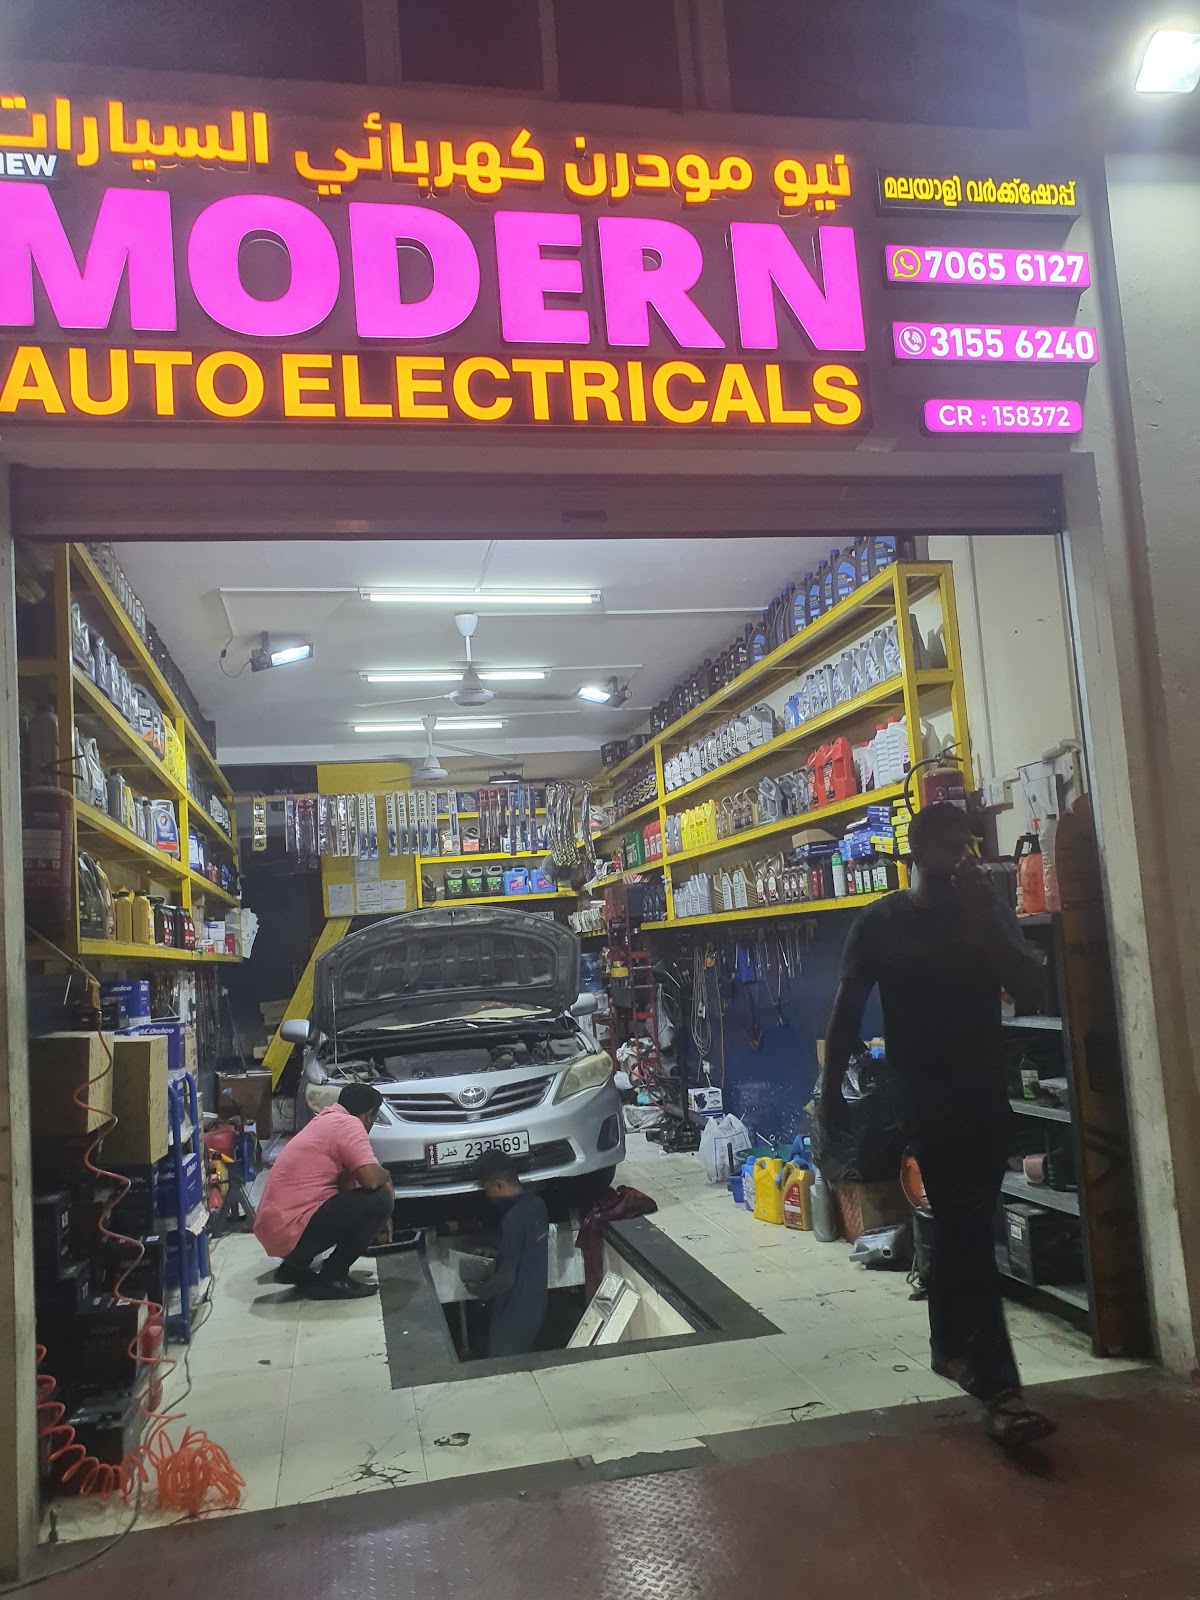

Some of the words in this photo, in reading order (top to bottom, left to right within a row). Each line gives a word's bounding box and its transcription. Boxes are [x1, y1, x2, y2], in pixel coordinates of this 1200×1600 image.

[0, 95, 270, 170] السيارات
[294, 111, 546, 196] كهربائي
[0, 152, 57, 177] EW
[564, 136, 753, 203] مودرن
[773, 153, 852, 211] نيو
[884, 175, 962, 207] മലയാളി
[0, 181, 866, 352] MODERN
[924, 250, 1006, 281] 7065
[1015, 253, 1085, 283] 6127
[929, 326, 1004, 358] 3155
[1015, 330, 1095, 360] 6240
[938, 405, 974, 427] CR
[992, 406, 1071, 427] 158372
